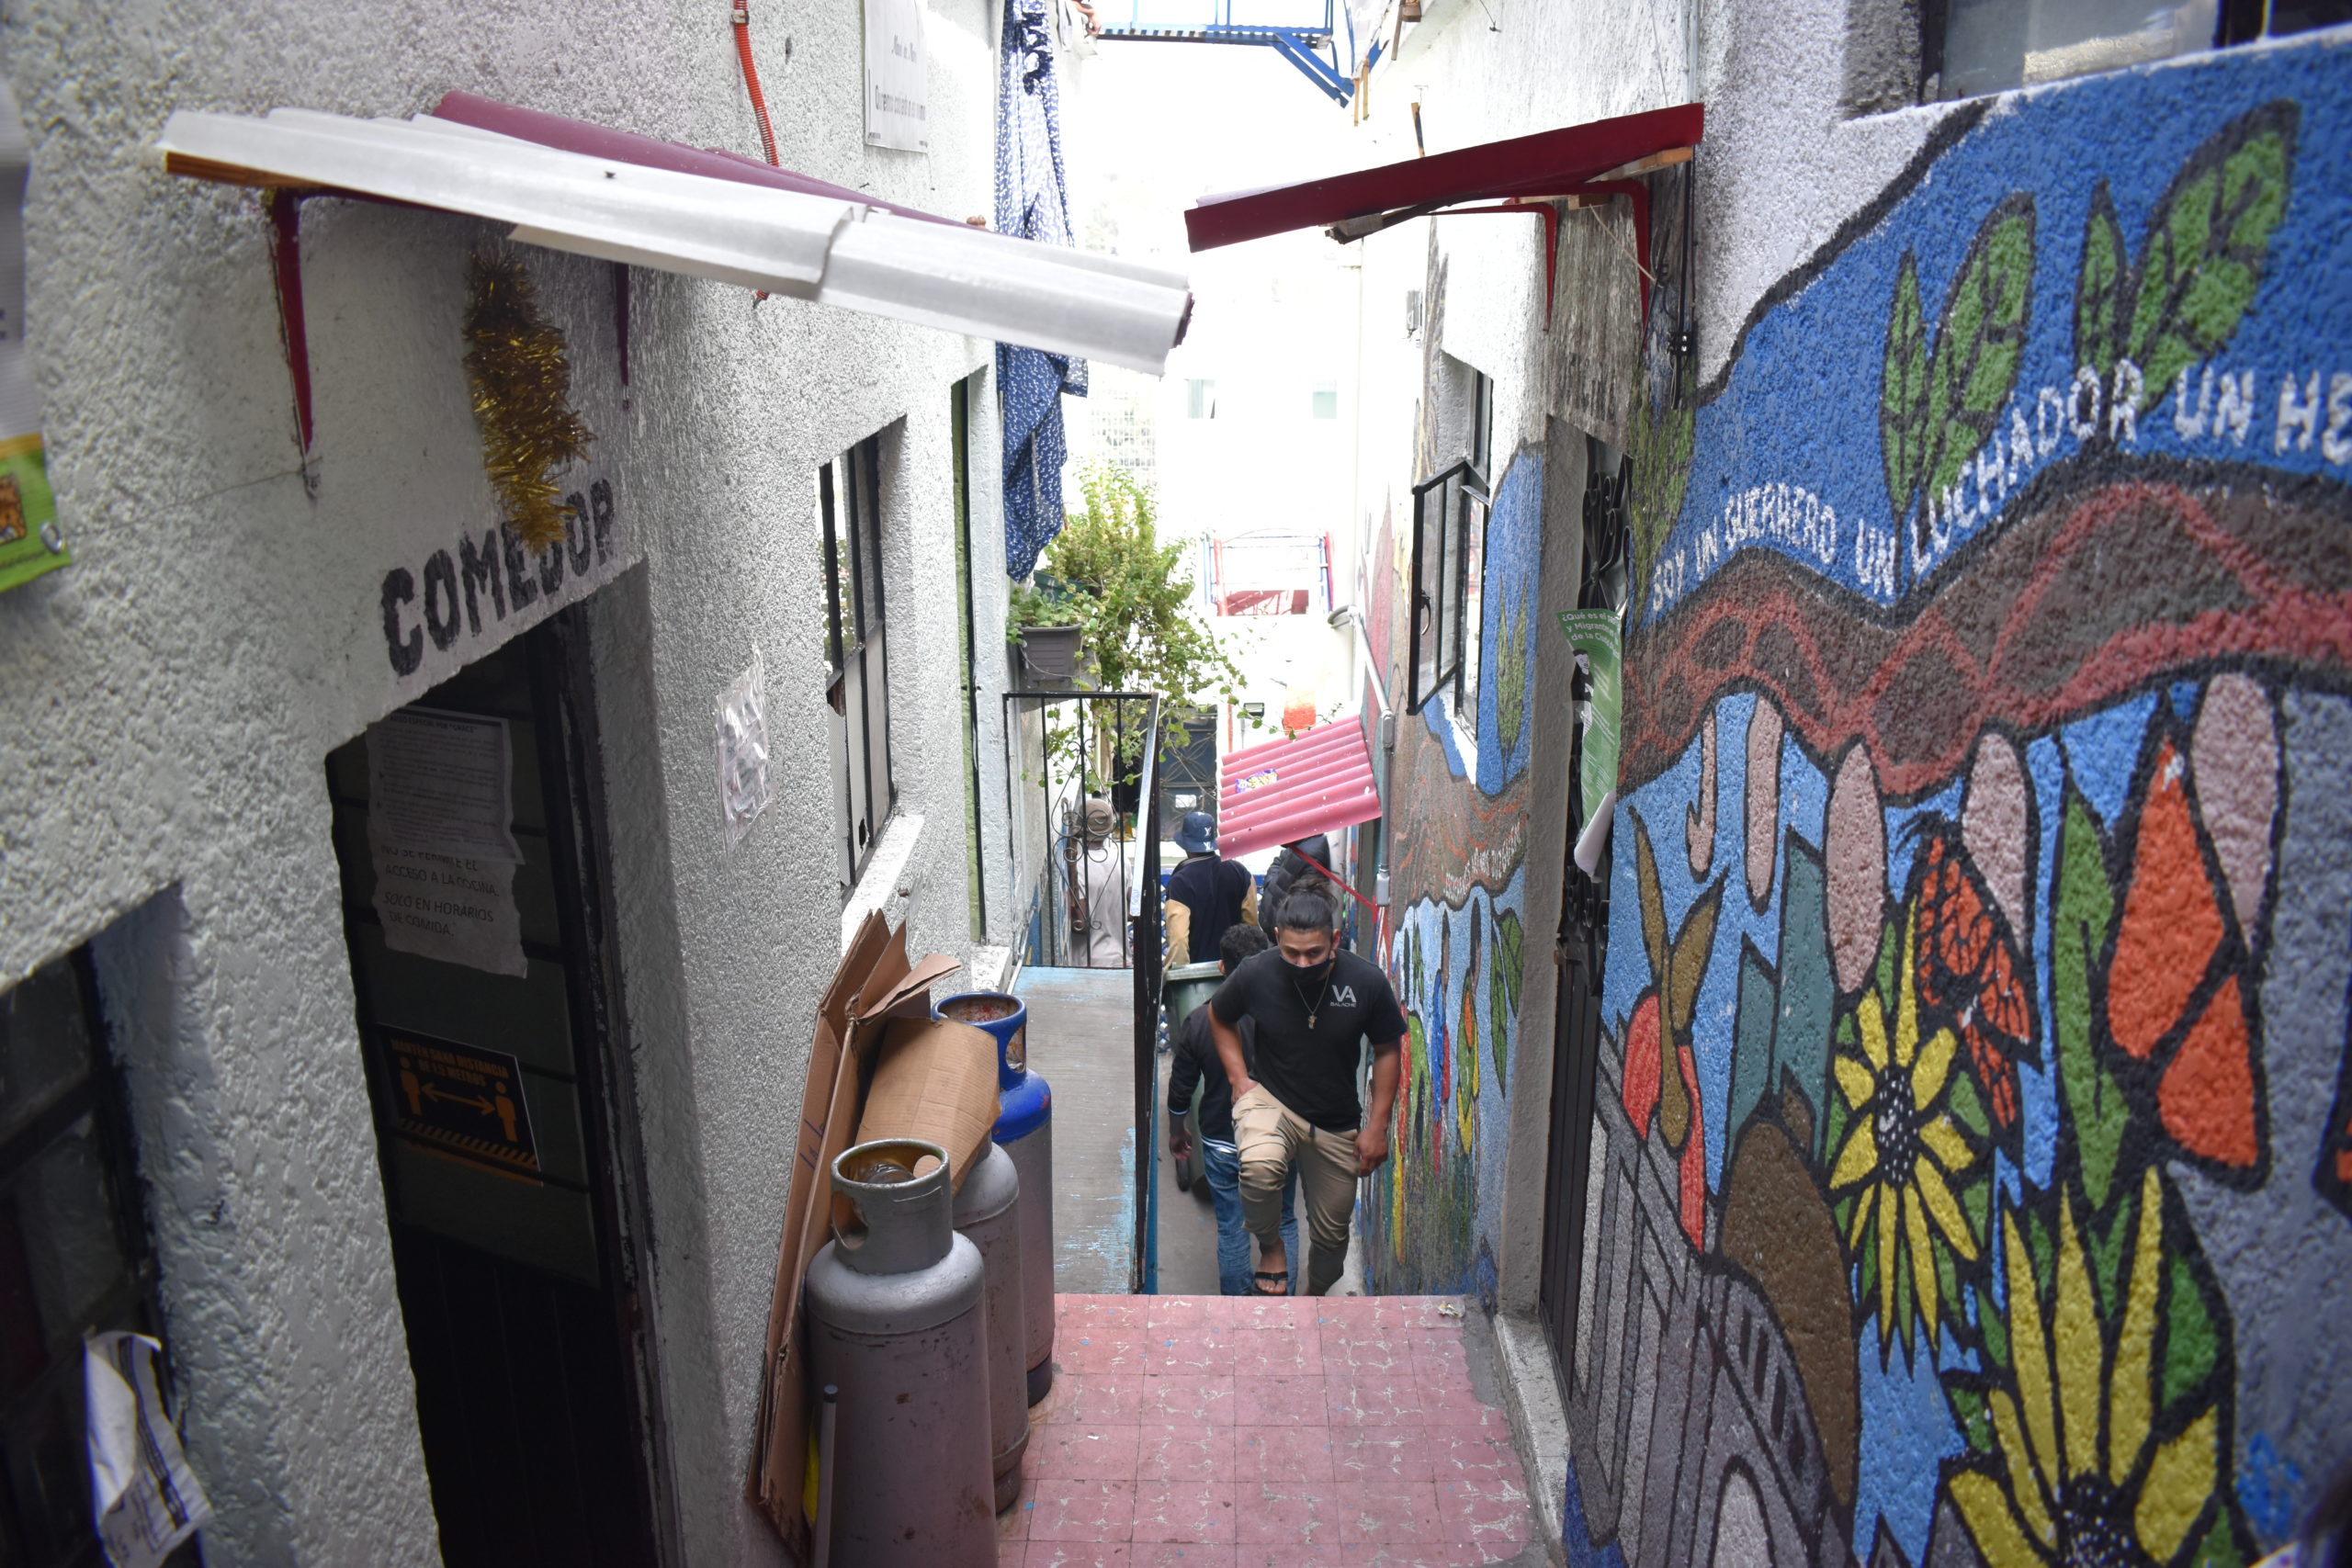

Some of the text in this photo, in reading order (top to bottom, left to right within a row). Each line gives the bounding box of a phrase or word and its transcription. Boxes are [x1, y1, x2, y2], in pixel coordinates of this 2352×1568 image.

[1653, 548, 1685, 613] SOY
[1696, 514, 1718, 581] UN
[1724, 482, 1836, 565] GUERRERO
[1856, 518, 1896, 595] UN
[1911, 358, 2144, 575] LUCHADOR
[2174, 365, 2253, 447] UN
[1566, 625, 1573, 633] y
[1571, 633, 1584, 641] de
[386, 864, 427, 882] ACCESO
[431, 872, 439, 884] A
[442, 873, 456, 885] LA
[383, 891, 494, 922] SOLO EN HORARIOS
[390, 910, 403, 923] DE
[1331, 985, 1357, 1002] VA
